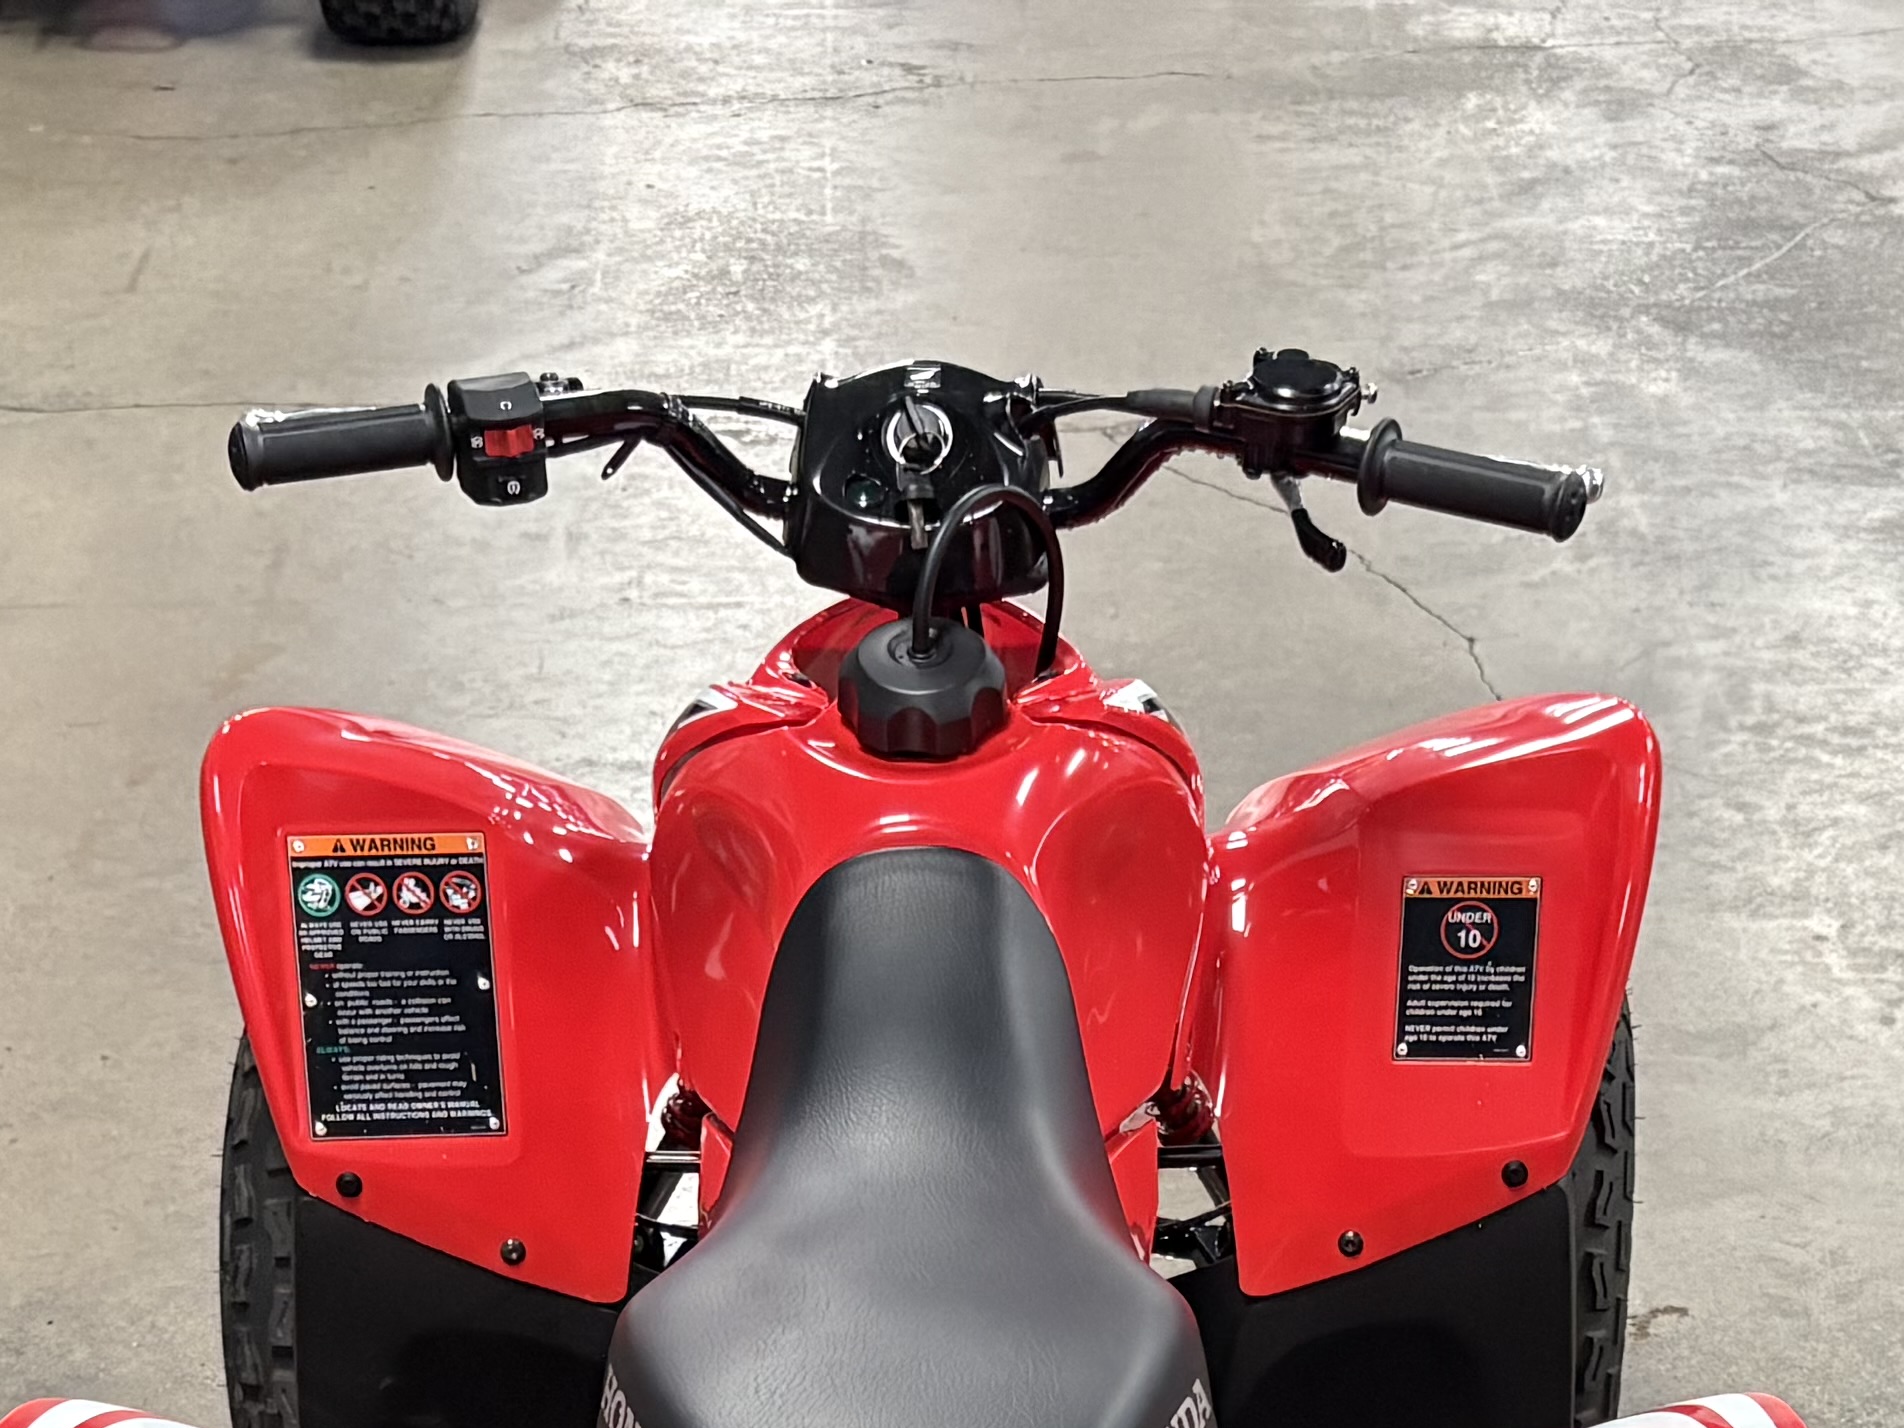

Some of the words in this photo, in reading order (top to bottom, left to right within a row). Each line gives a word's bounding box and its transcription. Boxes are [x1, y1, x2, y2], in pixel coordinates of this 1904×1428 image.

[350, 837, 436, 853] WARNING
[1437, 881, 1523, 895] WARNING
[1448, 912, 1491, 923] UNDER
[1457, 930, 1481, 948] 10
